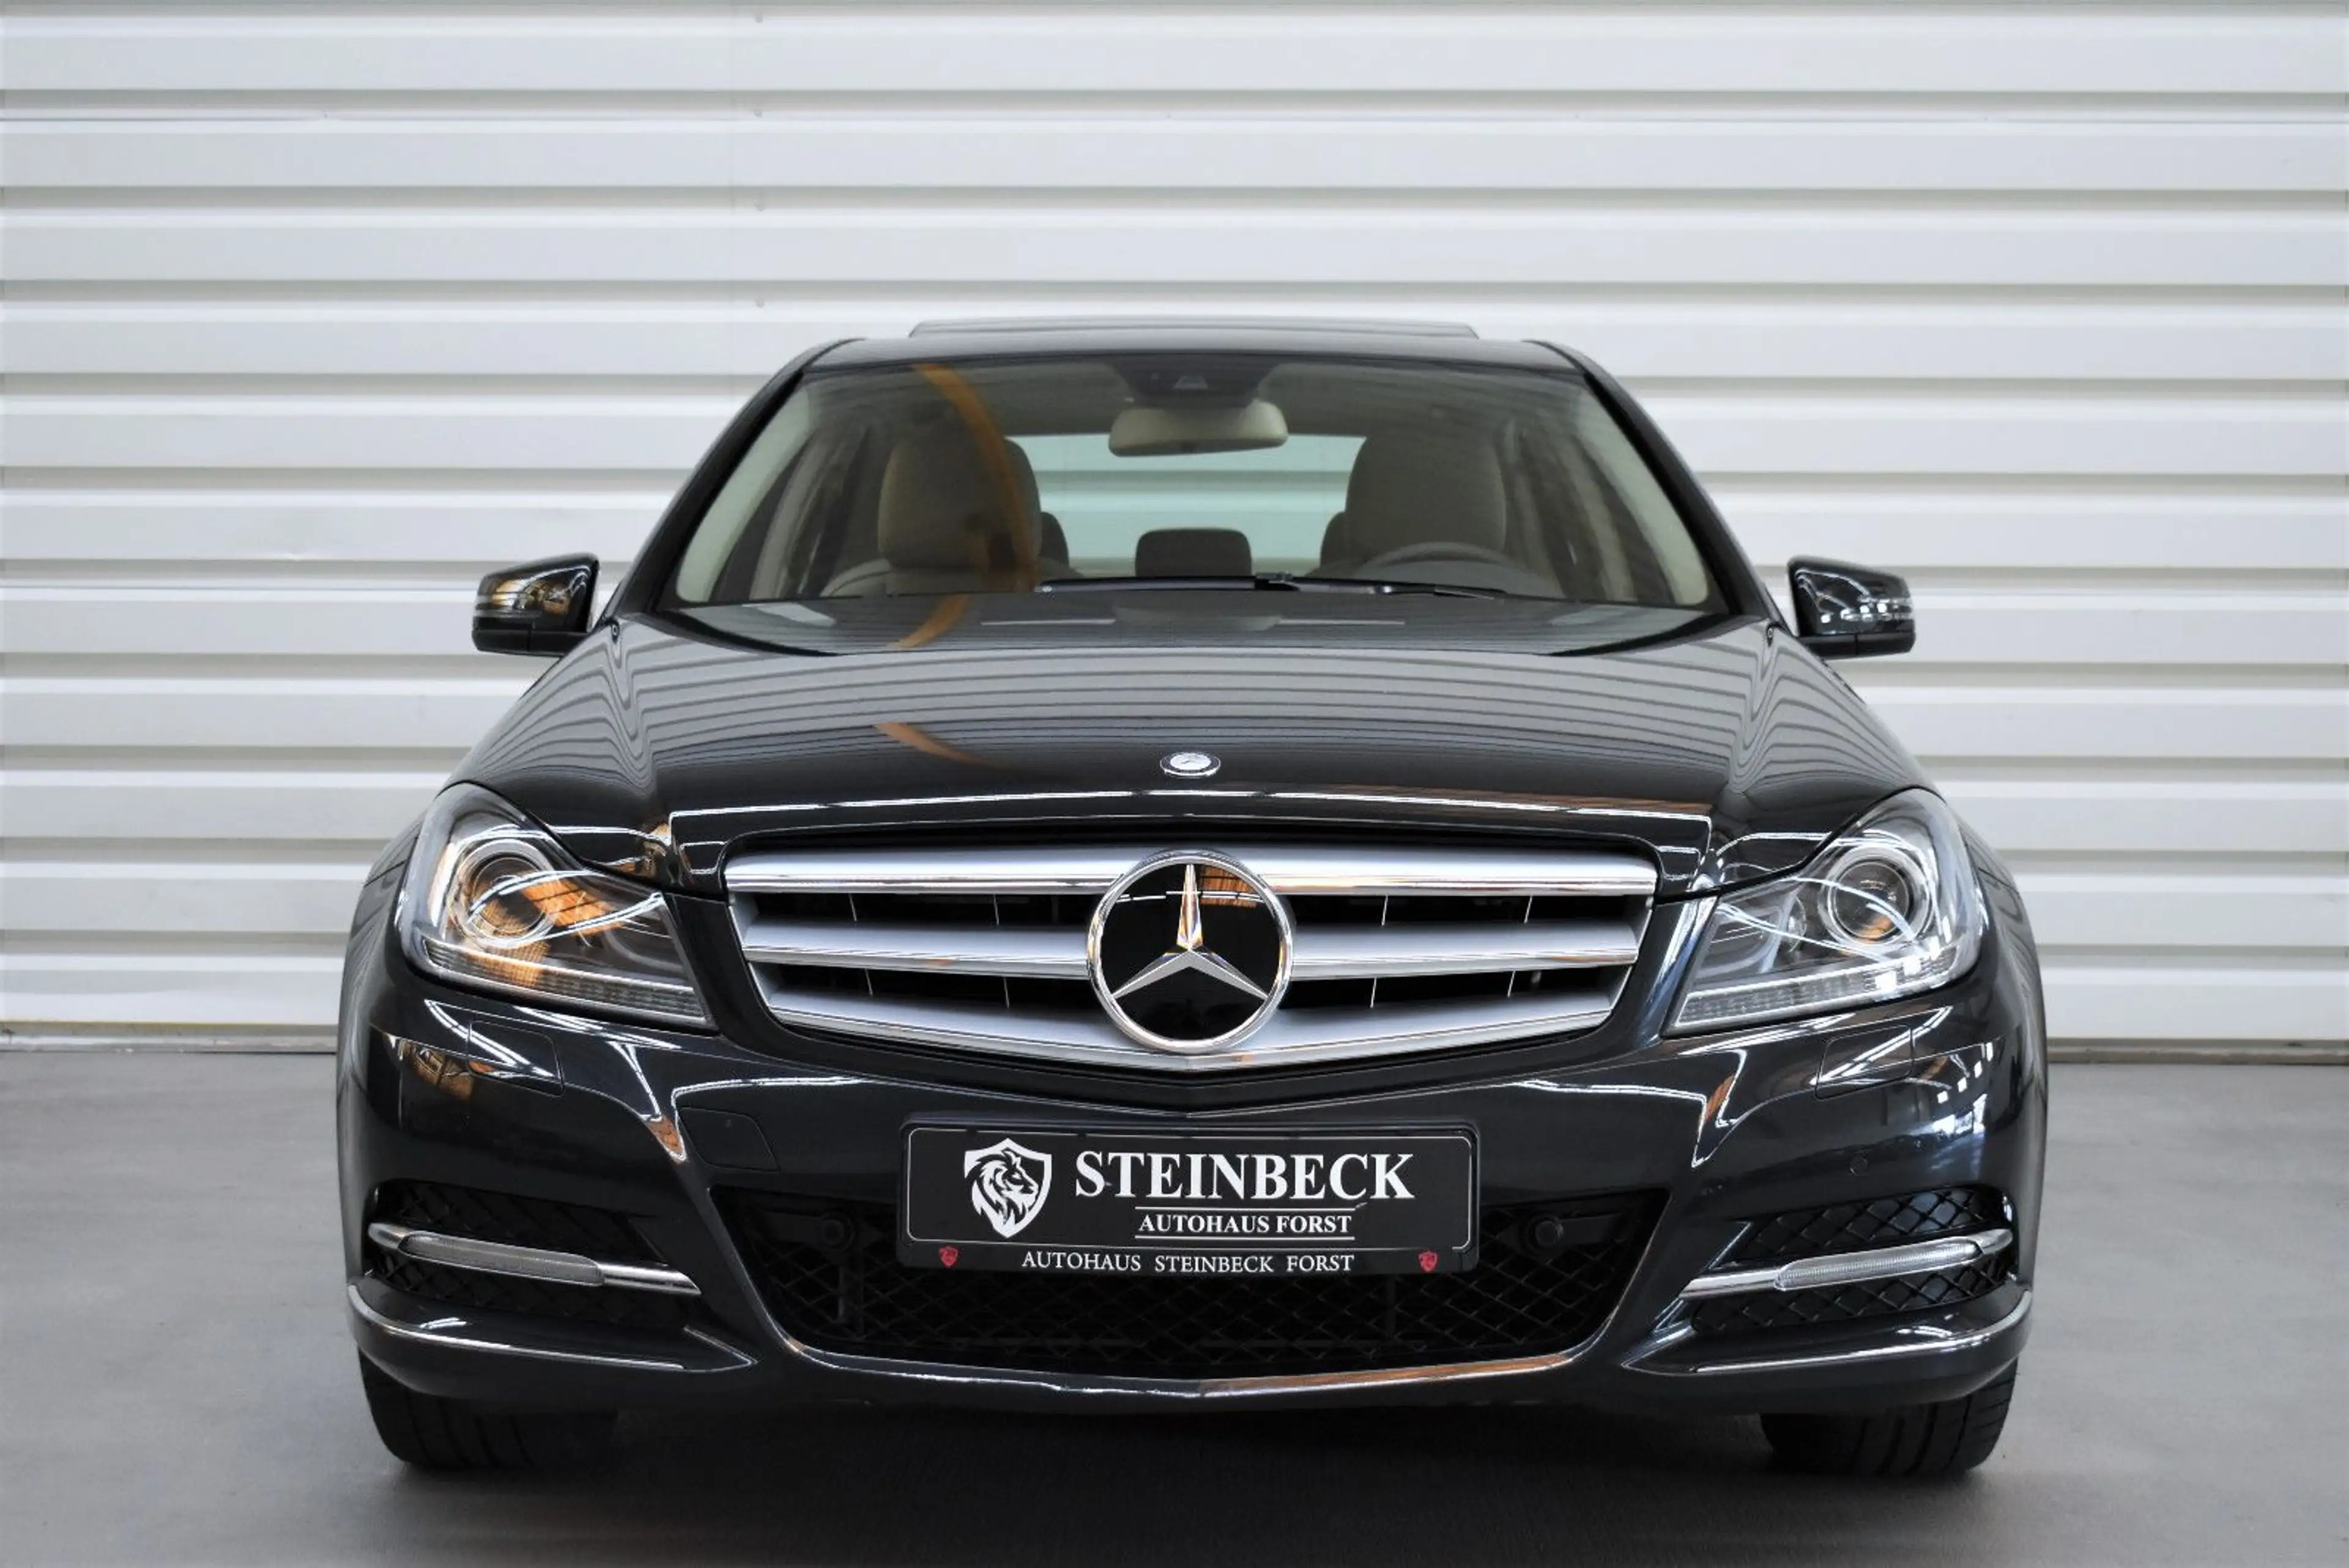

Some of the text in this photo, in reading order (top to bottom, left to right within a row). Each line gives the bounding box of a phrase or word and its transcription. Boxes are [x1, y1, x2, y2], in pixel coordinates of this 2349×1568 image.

[1075, 1150, 1415, 1200] STEINBECK
[1138, 1214, 1353, 1234] AUTOHAUS FORST
[1022, 1250, 1355, 1273] AUTOHAUS STEINBECK FORST
